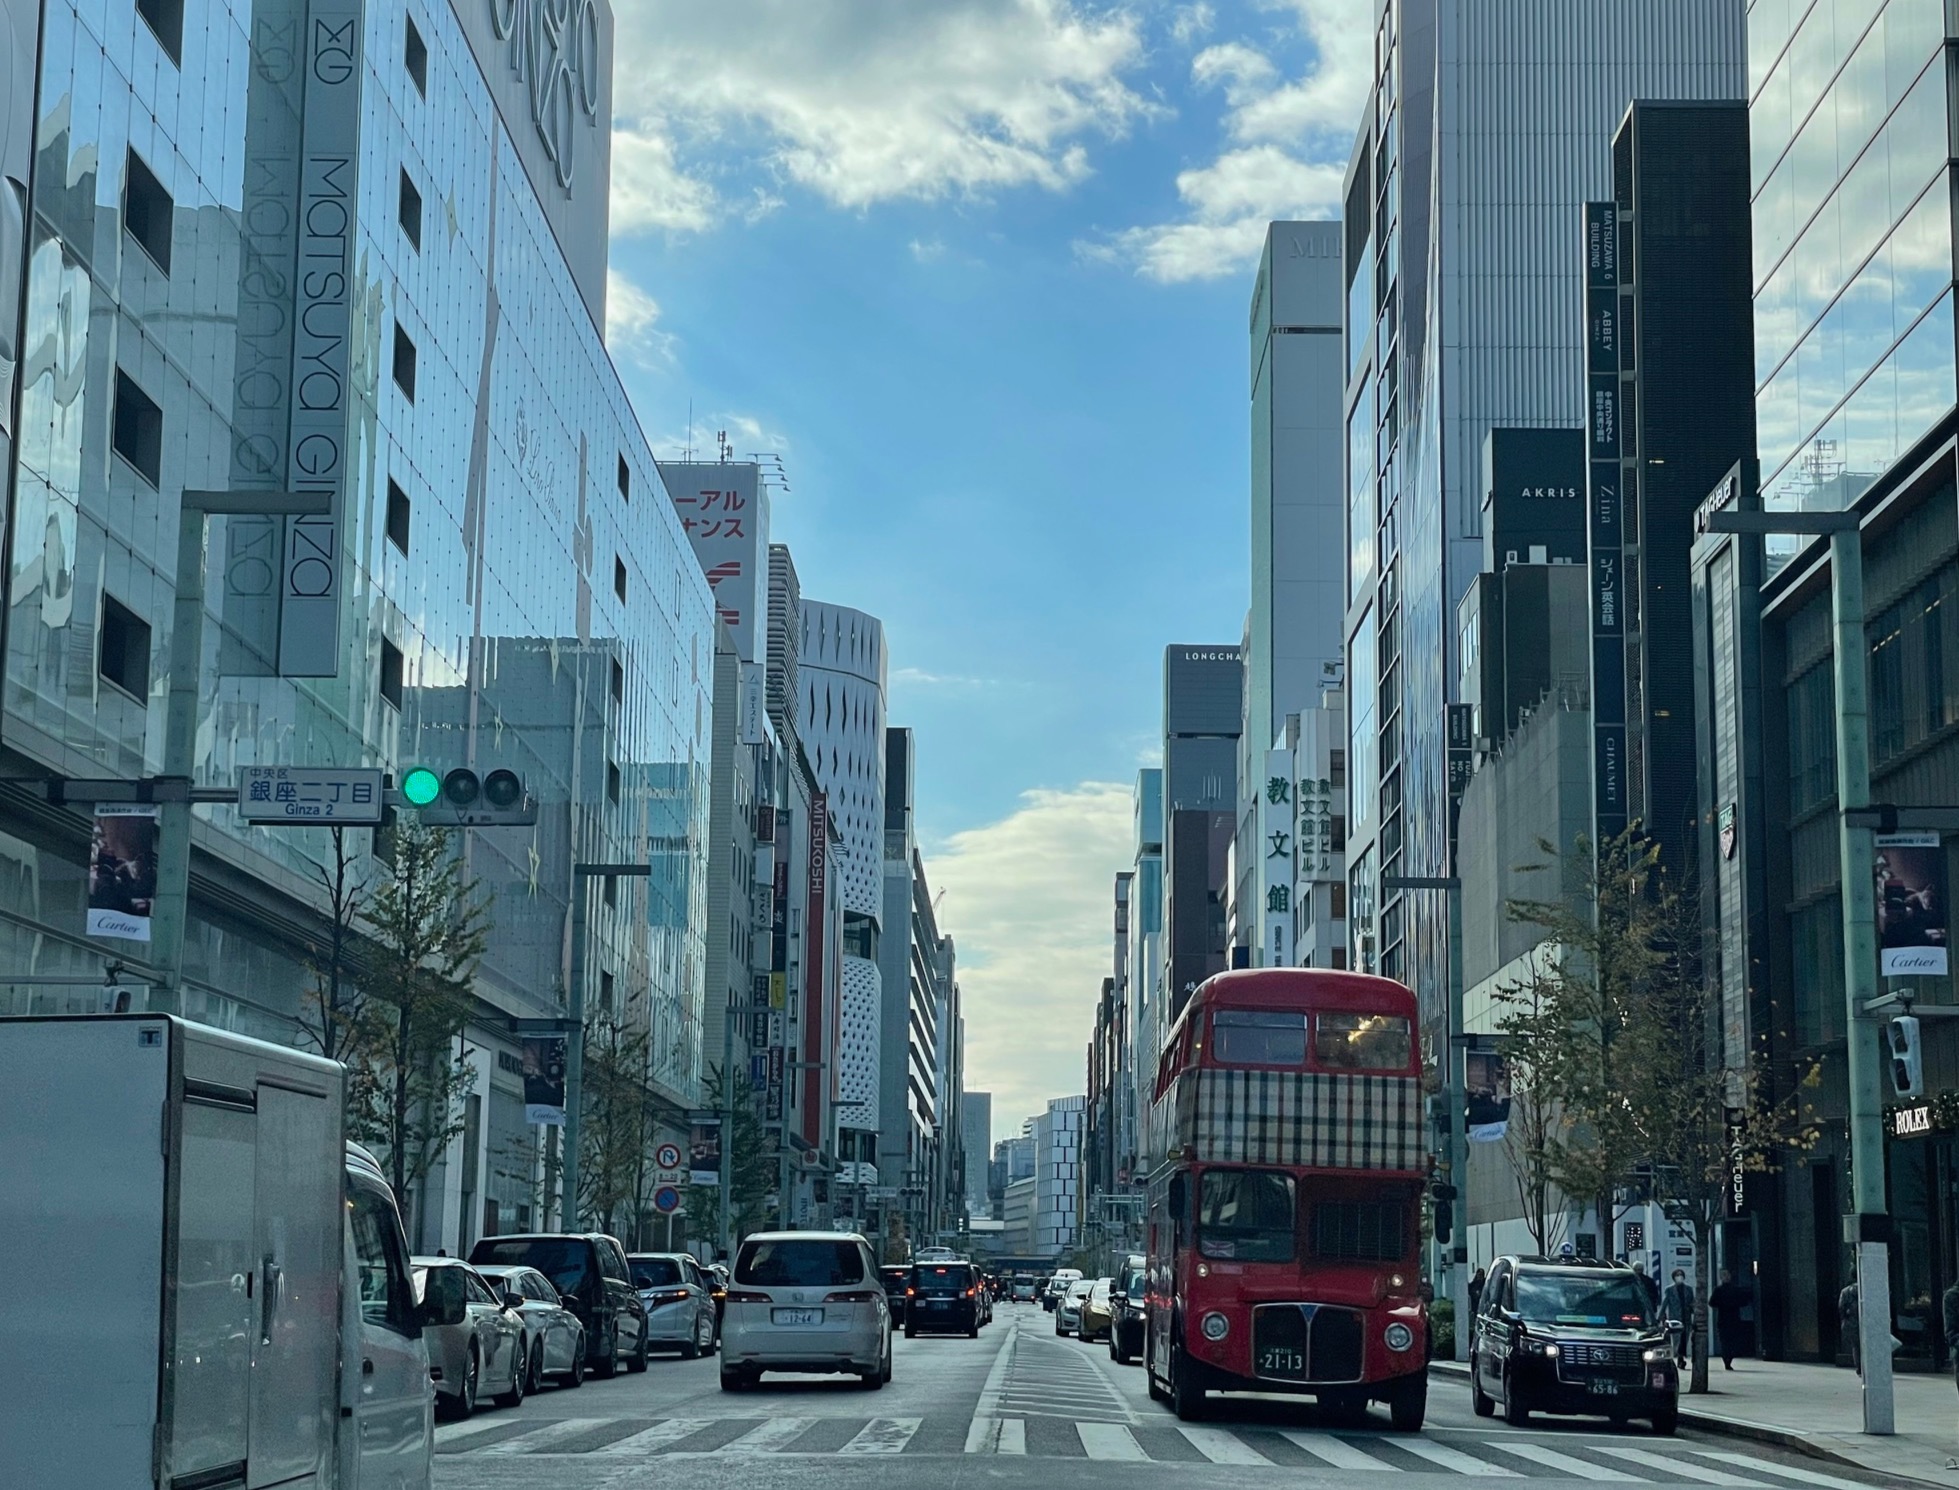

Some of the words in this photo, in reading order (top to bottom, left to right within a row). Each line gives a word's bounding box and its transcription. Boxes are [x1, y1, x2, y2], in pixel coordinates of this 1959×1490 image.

[1590, 222, 1600, 268] BUILDING
[1603, 210, 1613, 270] MATSUZAWA
[1602, 309, 1612, 351] ABBEY
[1521, 487, 1577, 498] AKRIS
[1600, 485, 1615, 524] Zina
[250, 769, 288, 779] 中央区
[1606, 737, 1616, 802] CHAUMET
[249, 781, 372, 803] 銀座二丁目
[285, 804, 320, 816] Ginza
[325, 804, 334, 816] 2
[812, 800, 824, 894] MITSUKOSHI
[1266, 776, 1290, 913] 教文館
[97, 915, 140, 934] Cartier
[1890, 953, 1938, 969] Cartier
[532, 1107, 560, 1121] Cartier
[1895, 1106, 1930, 1134] ROLEX
[1264, 1353, 1302, 1369] 21-13
[1592, 1384, 1618, 1394] 65-86
